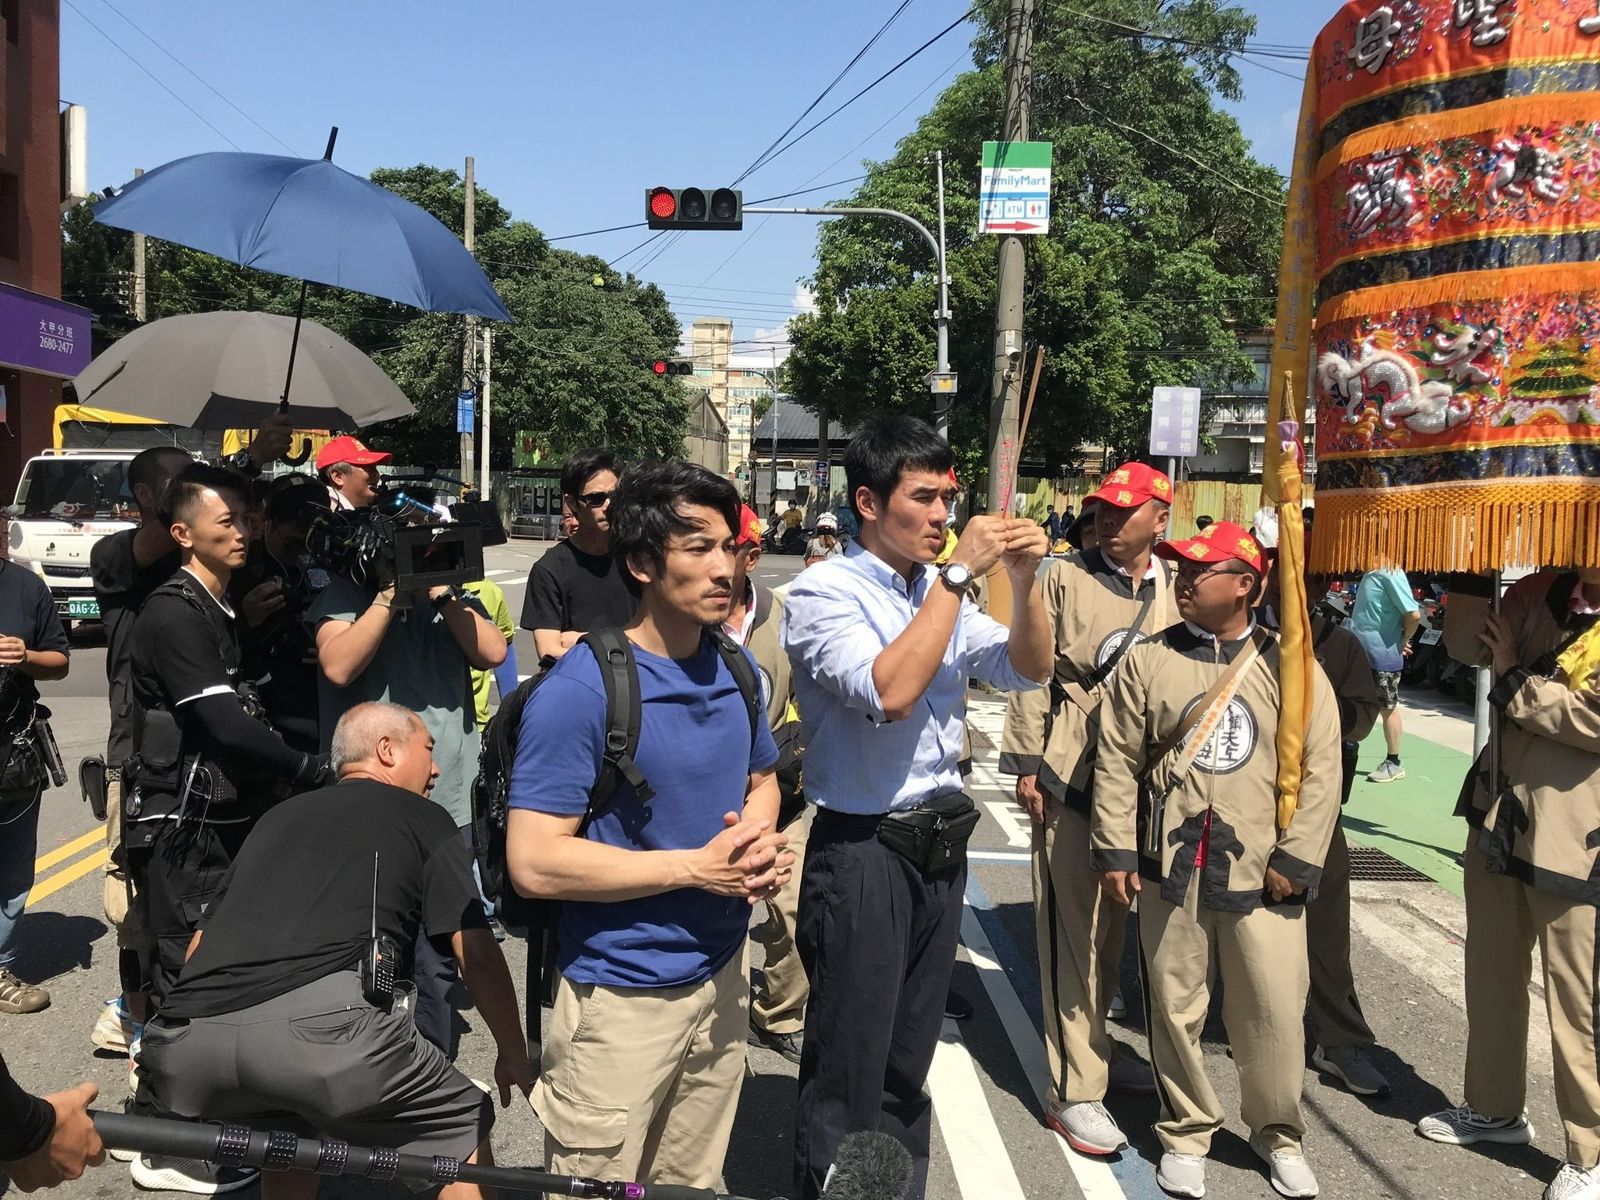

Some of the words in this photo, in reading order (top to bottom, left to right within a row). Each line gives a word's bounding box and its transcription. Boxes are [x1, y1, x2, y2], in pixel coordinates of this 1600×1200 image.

[984, 175, 1047, 187] FamilyMart
[1007, 205, 1023, 214] ATM
[39, 336, 74, 354] 2680-2477
